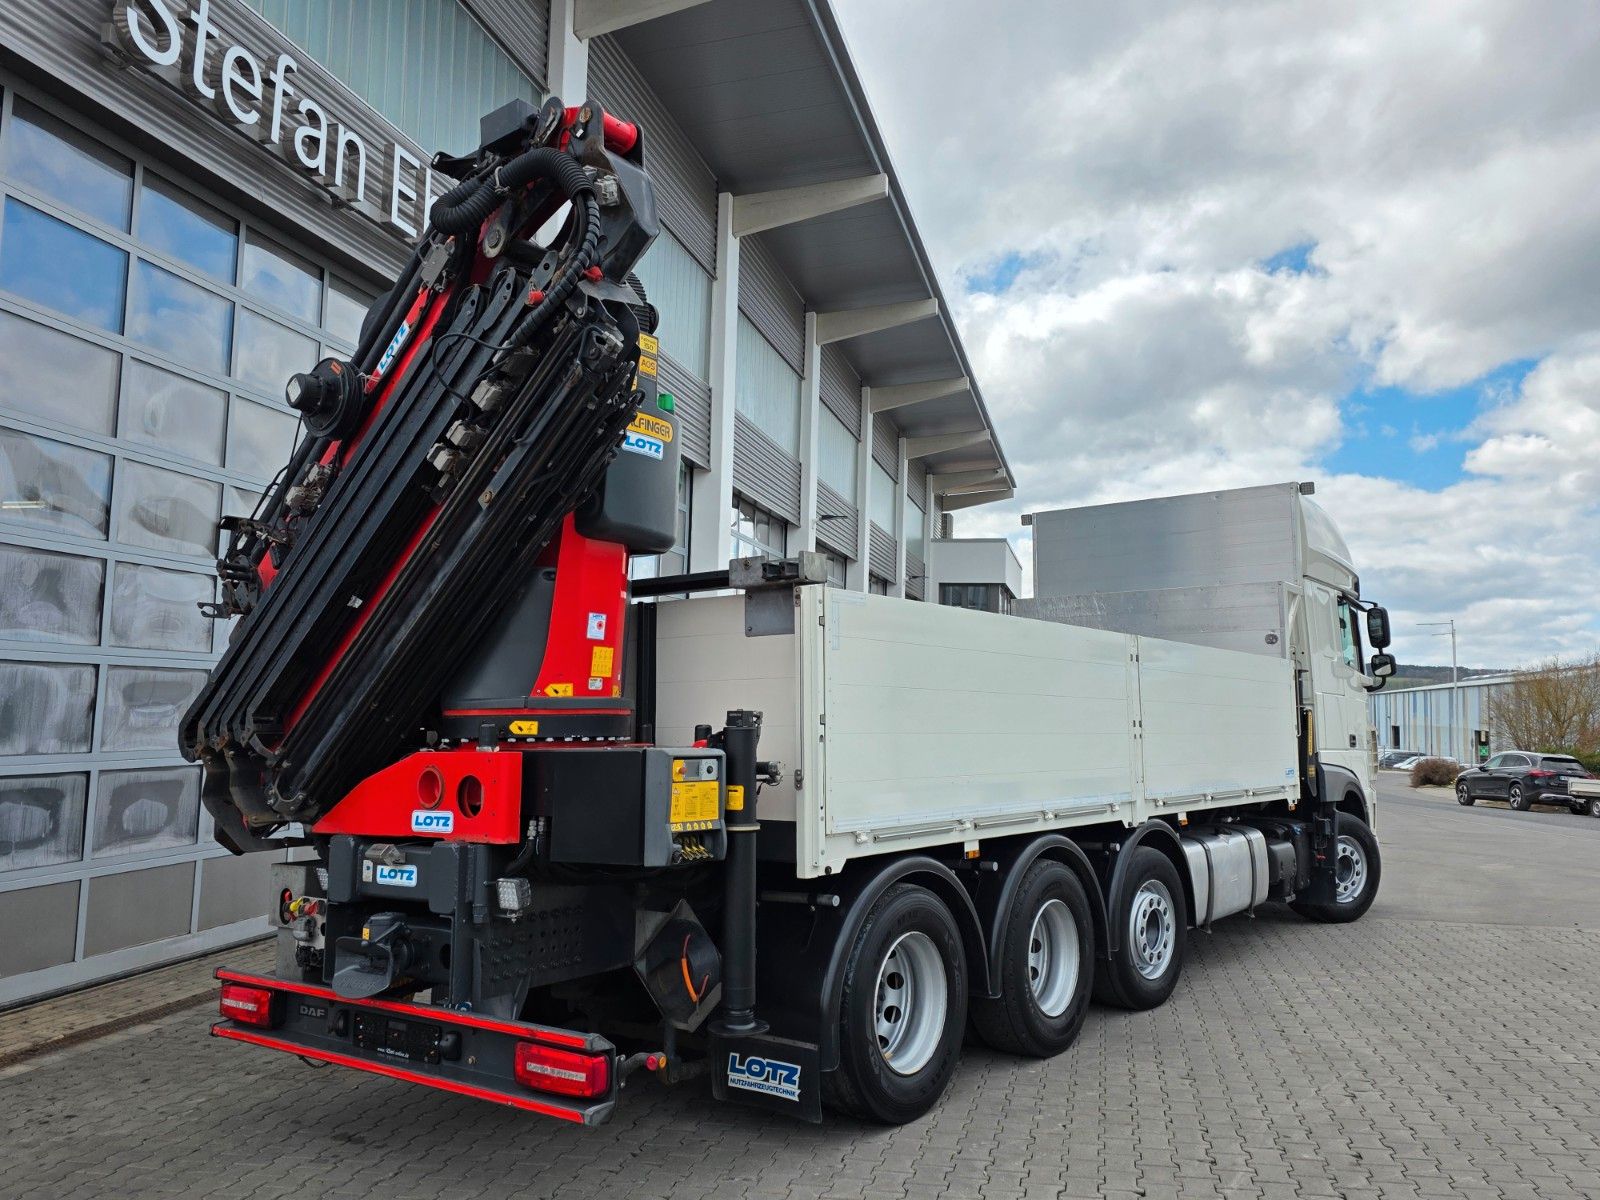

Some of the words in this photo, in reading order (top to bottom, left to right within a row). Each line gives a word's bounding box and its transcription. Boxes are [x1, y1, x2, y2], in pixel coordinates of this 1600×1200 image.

[127, 0, 366, 201] Stefan
[380, 324, 406, 370] LOTZ
[625, 435, 662, 455] LOTZ
[415, 815, 450, 827] LOTZ
[379, 868, 415, 881] LOTZ
[299, 1005, 326, 1018] DAF
[728, 1053, 800, 1088] LOTZ
[729, 1077, 797, 1098] NUTZFAHRZEUGTECHNIK
